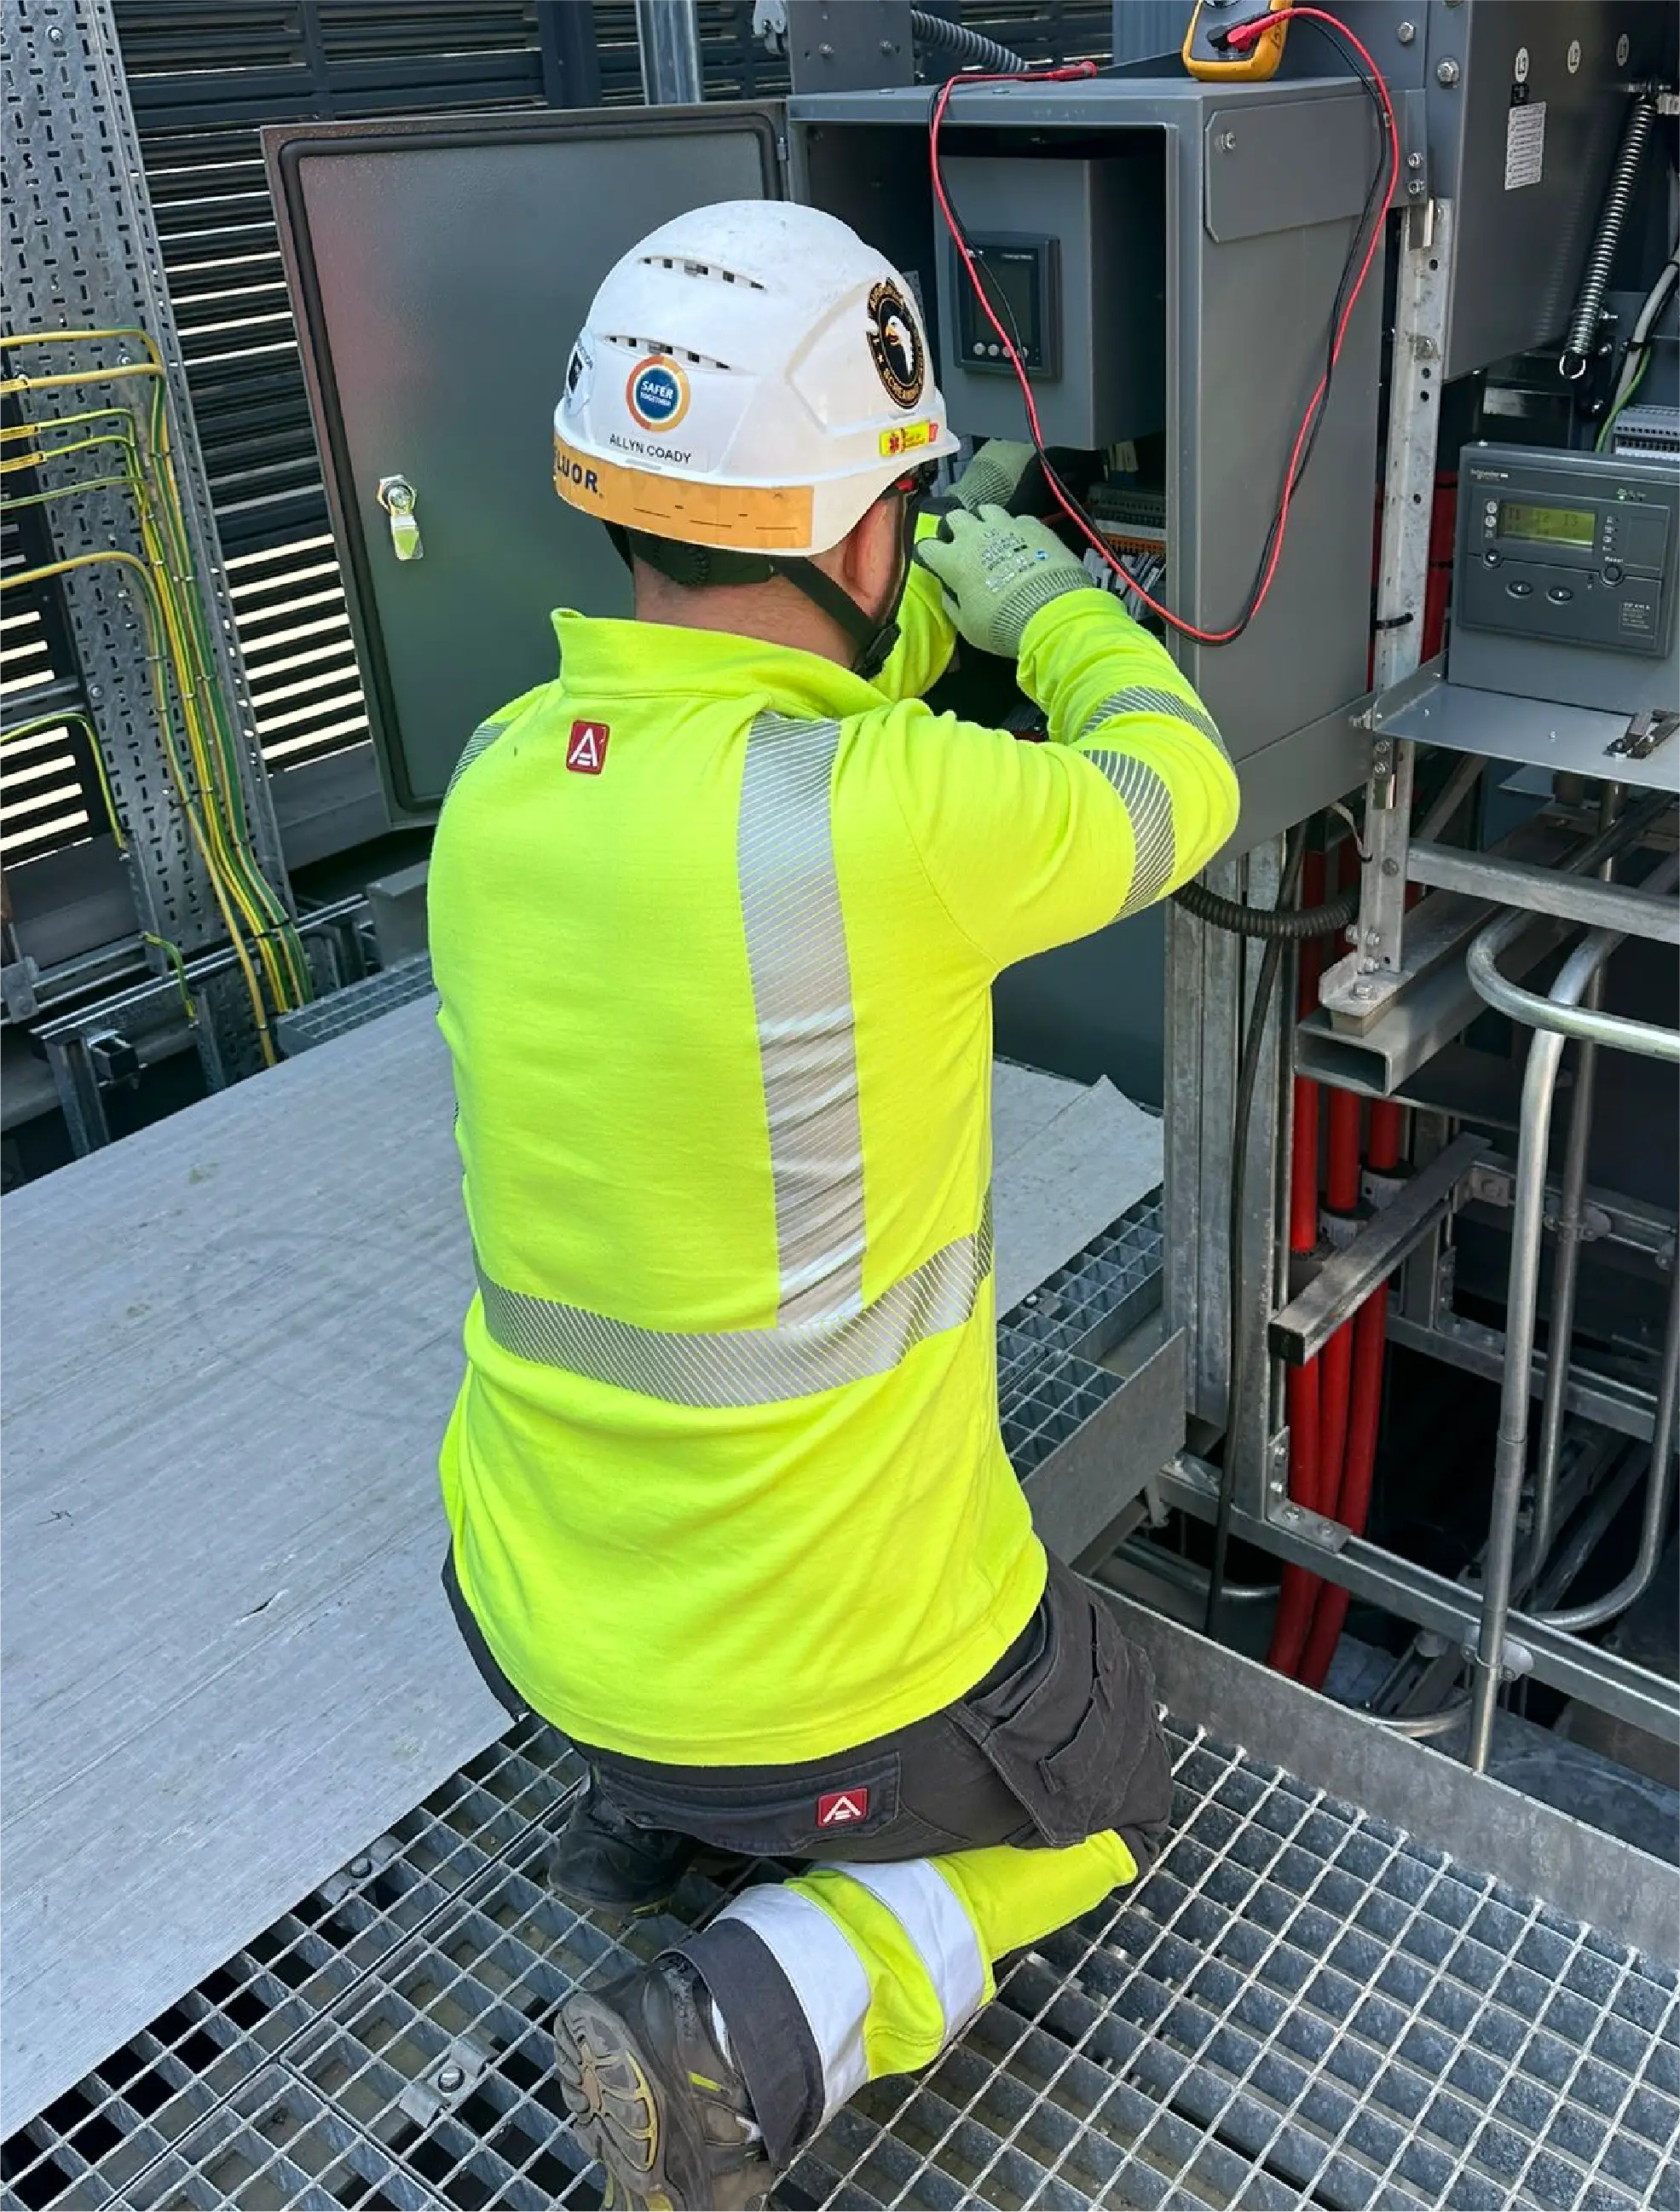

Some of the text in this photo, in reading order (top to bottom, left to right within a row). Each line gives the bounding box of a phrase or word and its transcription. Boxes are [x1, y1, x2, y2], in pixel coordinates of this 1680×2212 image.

[640, 380, 674, 400] SAFER
[609, 433, 691, 464] ALLYN COADY
[554, 448, 598, 494] LUOR
